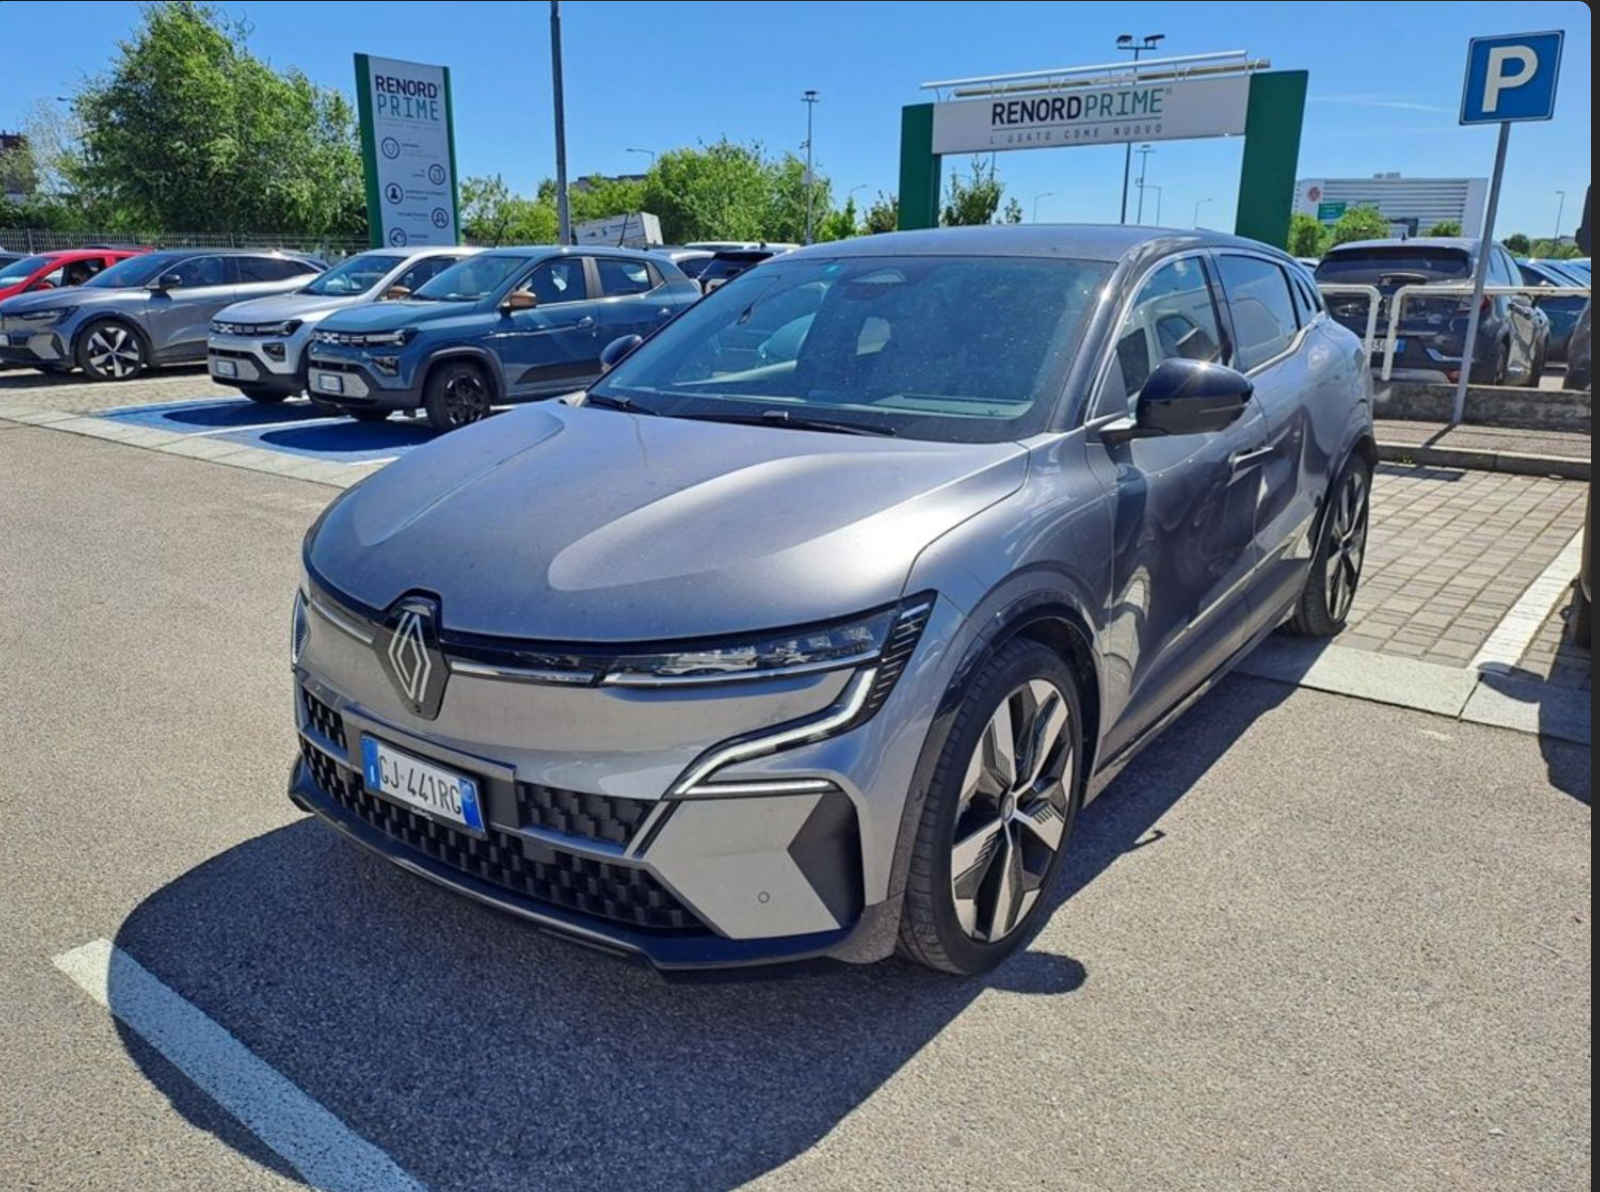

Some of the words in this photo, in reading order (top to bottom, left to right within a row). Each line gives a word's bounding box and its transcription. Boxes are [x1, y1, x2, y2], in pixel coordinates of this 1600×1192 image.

[374, 74, 438, 99] RENORD
[1481, 45, 1538, 113] P
[376, 93, 439, 121] PRIME
[1064, 127, 1099, 140] COME
[1113, 123, 1162, 136] NUOVO
